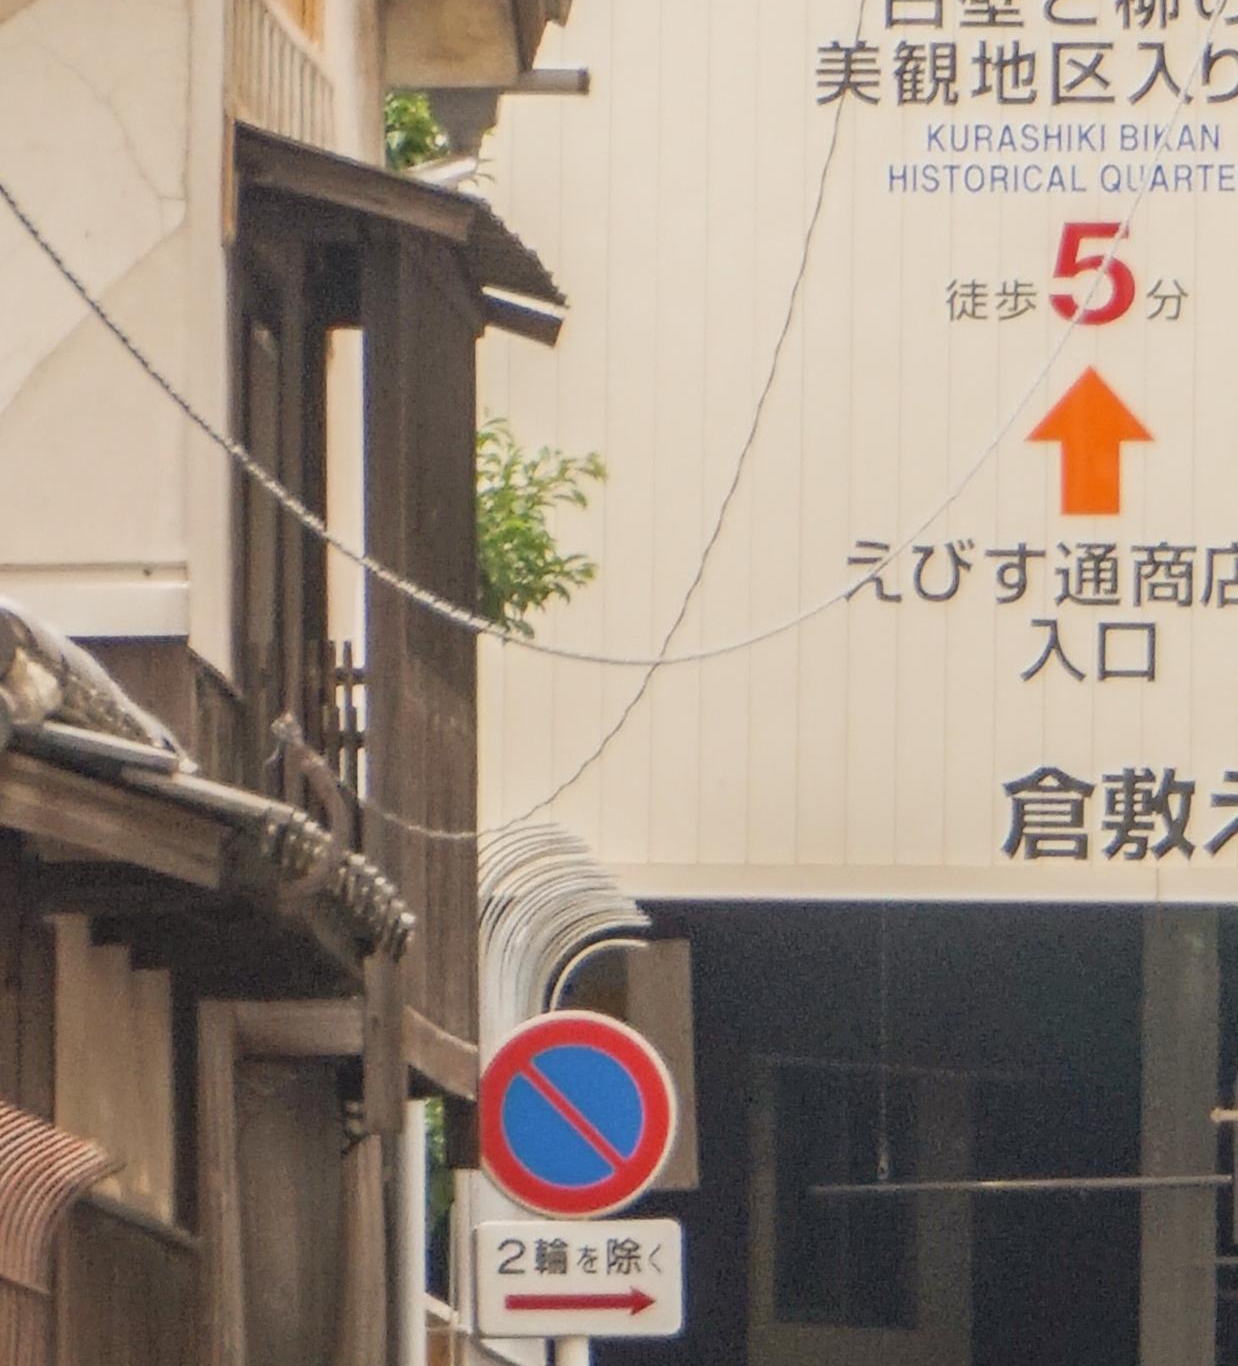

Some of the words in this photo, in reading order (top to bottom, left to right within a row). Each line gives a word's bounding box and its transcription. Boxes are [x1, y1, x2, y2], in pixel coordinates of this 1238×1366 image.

[927, 123, 1107, 152] KURASHIKI
[1119, 123, 1221, 152] BIKAN
[888, 163, 1086, 192] HISTORICAL
[945, 221, 1190, 326] 徒歩5分
[1019, 616, 1158, 684] 入口
[496, 1237, 664, 1277] 2輪を除く
